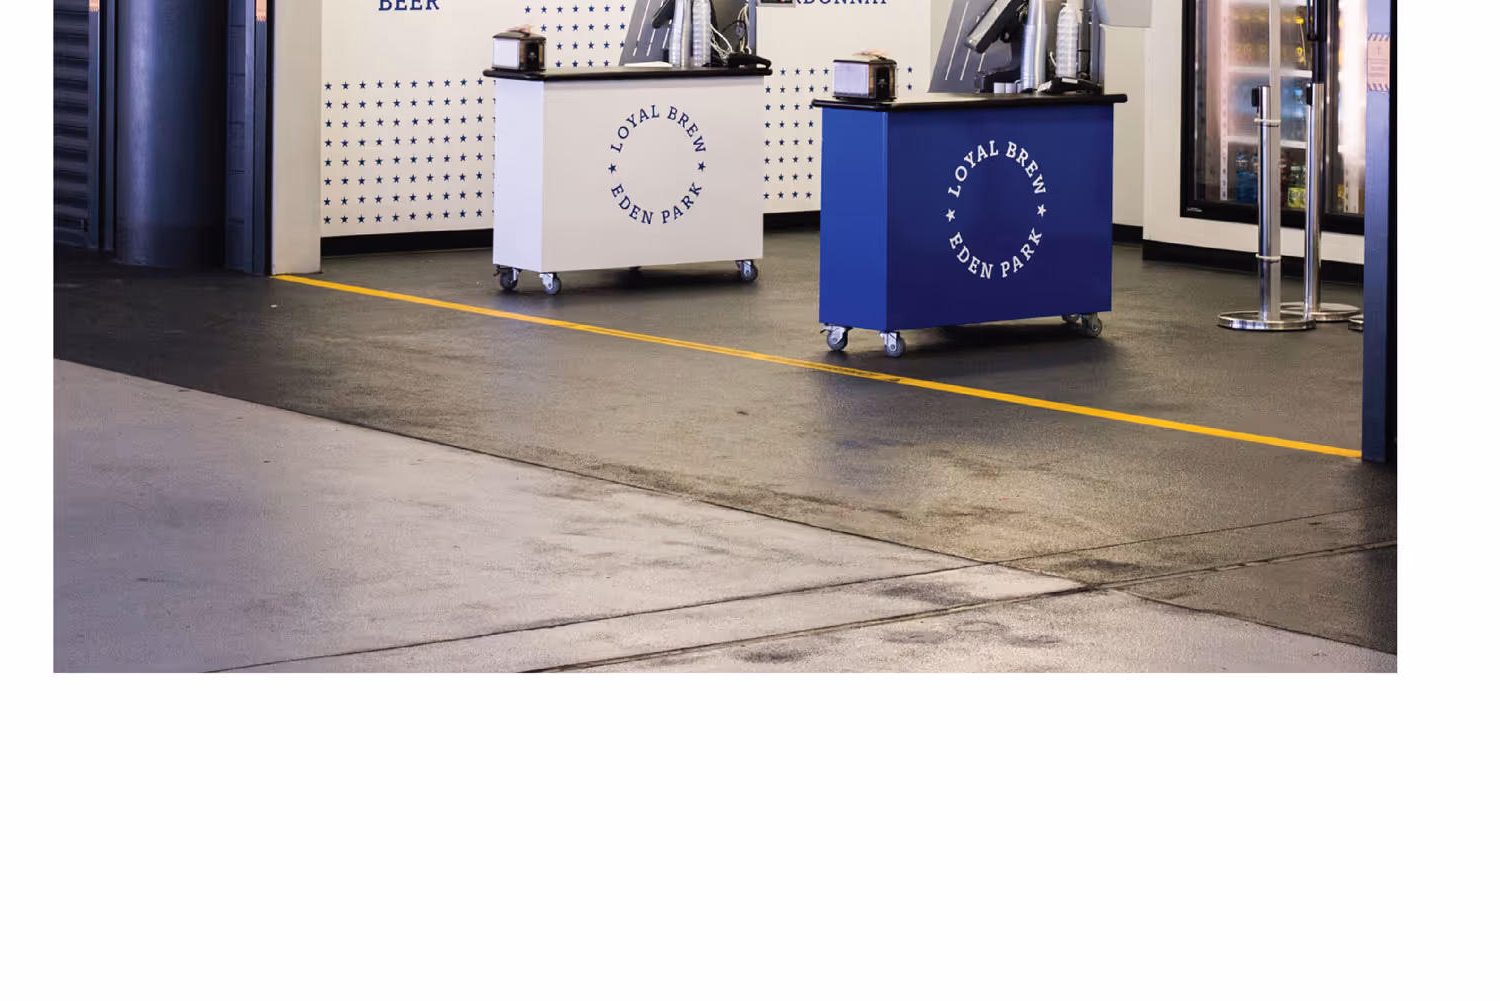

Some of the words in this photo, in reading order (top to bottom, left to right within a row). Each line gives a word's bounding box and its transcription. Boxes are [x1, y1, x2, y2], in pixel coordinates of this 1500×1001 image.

[610, 104, 660, 153] LOYAL
[667, 105, 707, 153] BREW
[947, 140, 999, 198] LOYAL
[1005, 141, 1047, 194] BREW
[610, 183, 654, 225] EDEN
[661, 181, 702, 225] PARK
[949, 231, 994, 280] EDEN
[1000, 227, 1043, 278] PARK
